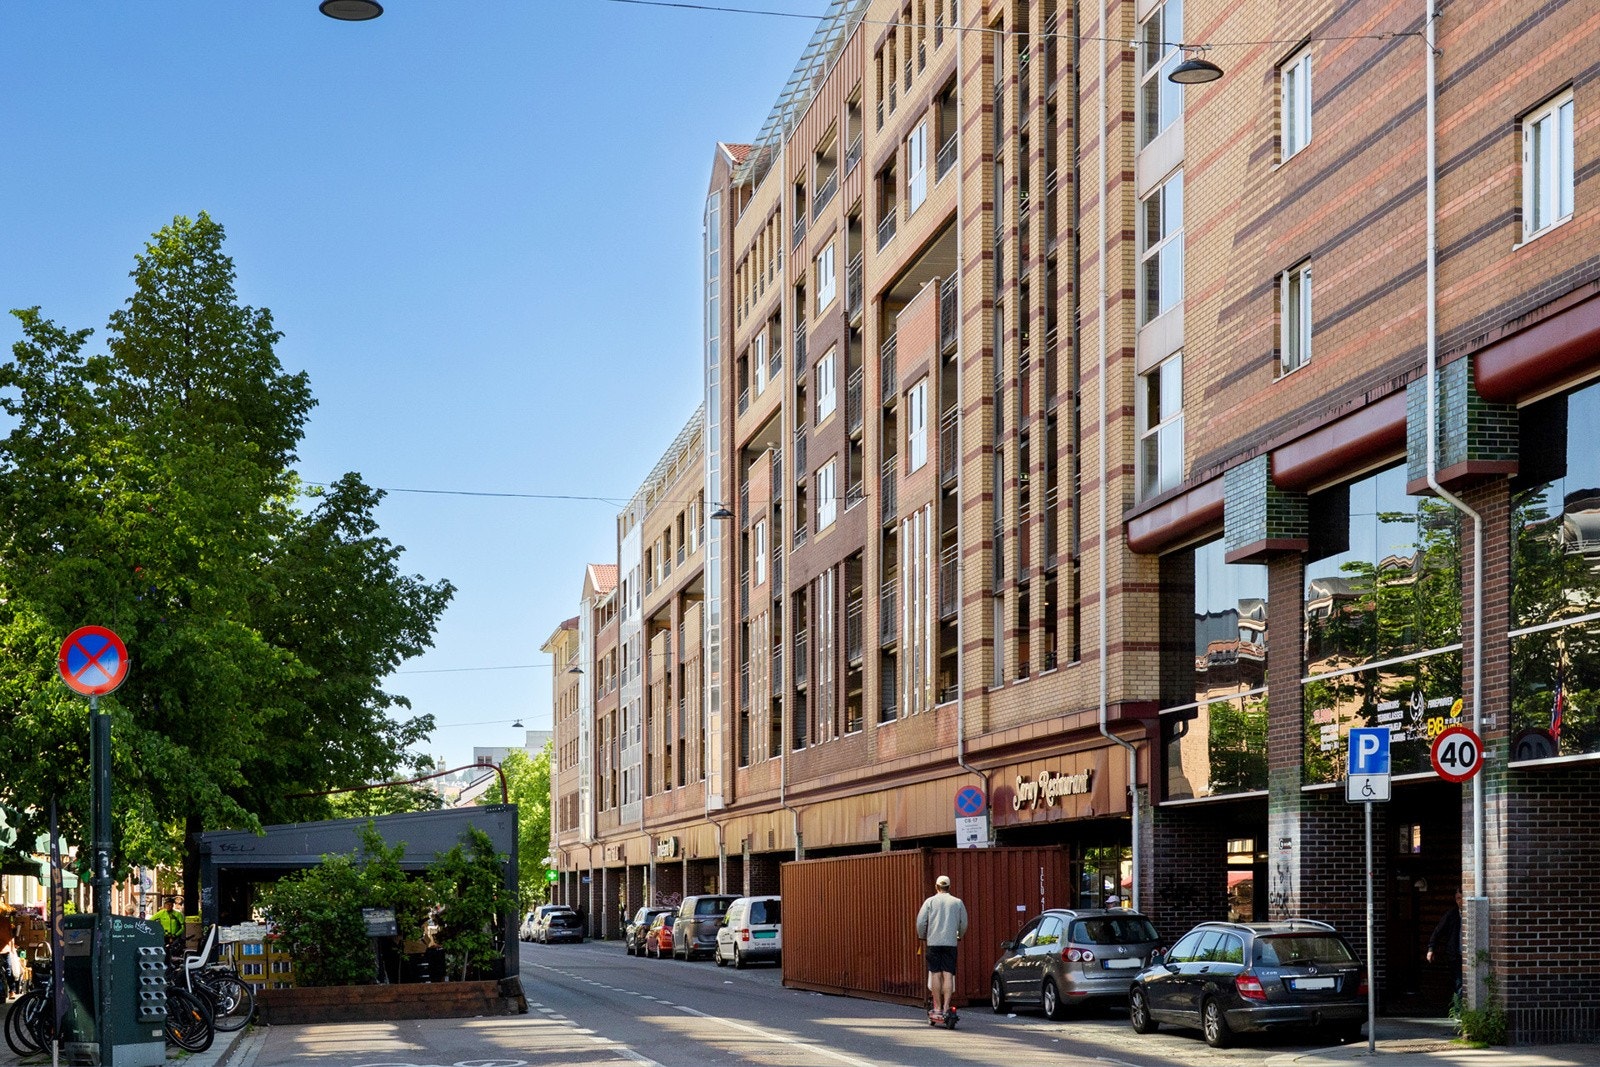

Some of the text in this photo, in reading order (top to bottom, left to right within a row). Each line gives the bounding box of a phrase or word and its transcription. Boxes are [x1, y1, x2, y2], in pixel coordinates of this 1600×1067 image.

[1359, 734, 1380, 769] P
[1440, 741, 1476, 768] 40
[1039, 768, 1089, 807] Restaurant
